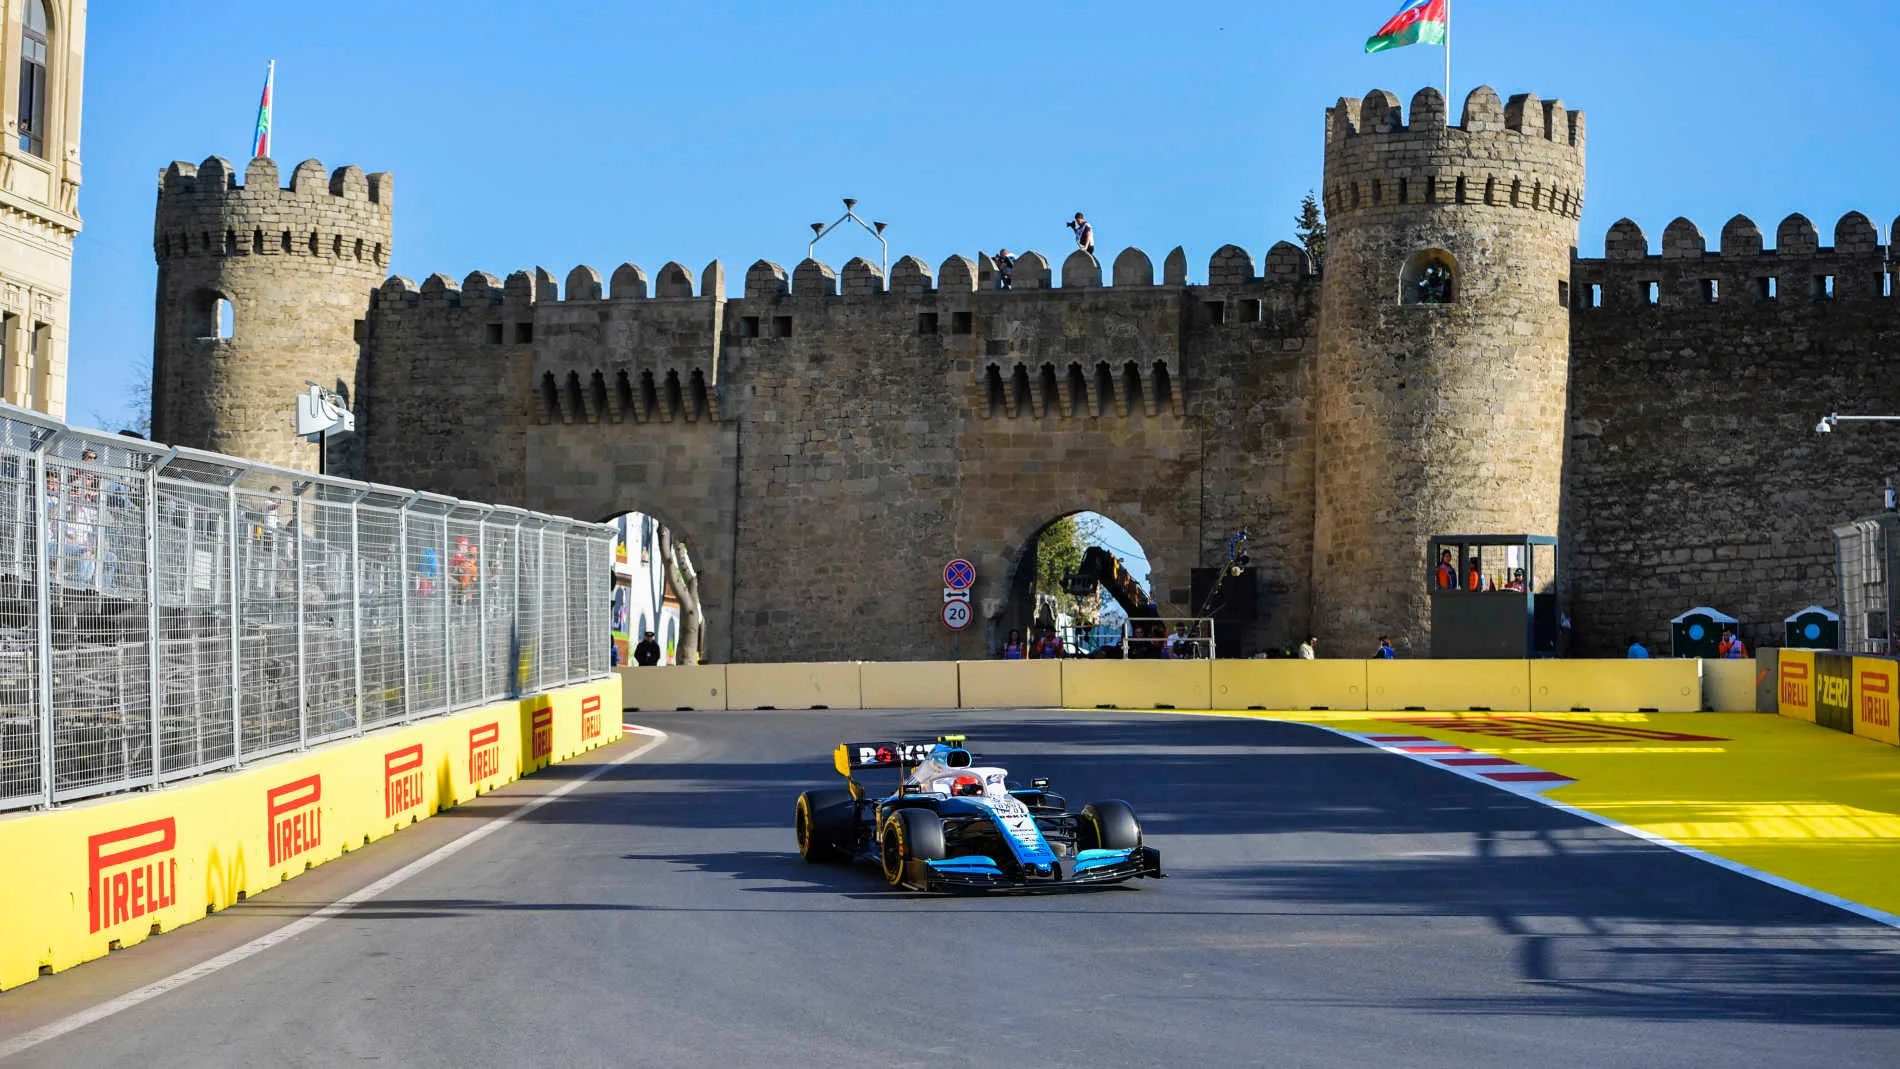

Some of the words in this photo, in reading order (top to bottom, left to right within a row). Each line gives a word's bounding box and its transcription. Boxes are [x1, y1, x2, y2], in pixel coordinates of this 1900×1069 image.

[949, 607, 966, 620] 20
[1780, 661, 1808, 707] PIRELLI
[1822, 676, 1849, 708] ZERO
[1860, 672, 1890, 727] PIRELLI
[531, 706, 553, 760] PIRELLI
[582, 695, 601, 741] PIRELLI
[469, 722, 499, 784] PIRELLI
[385, 743, 423, 818] PIRELLI
[267, 774, 321, 867] PIRELLI
[88, 816, 176, 934] PIRELLI
